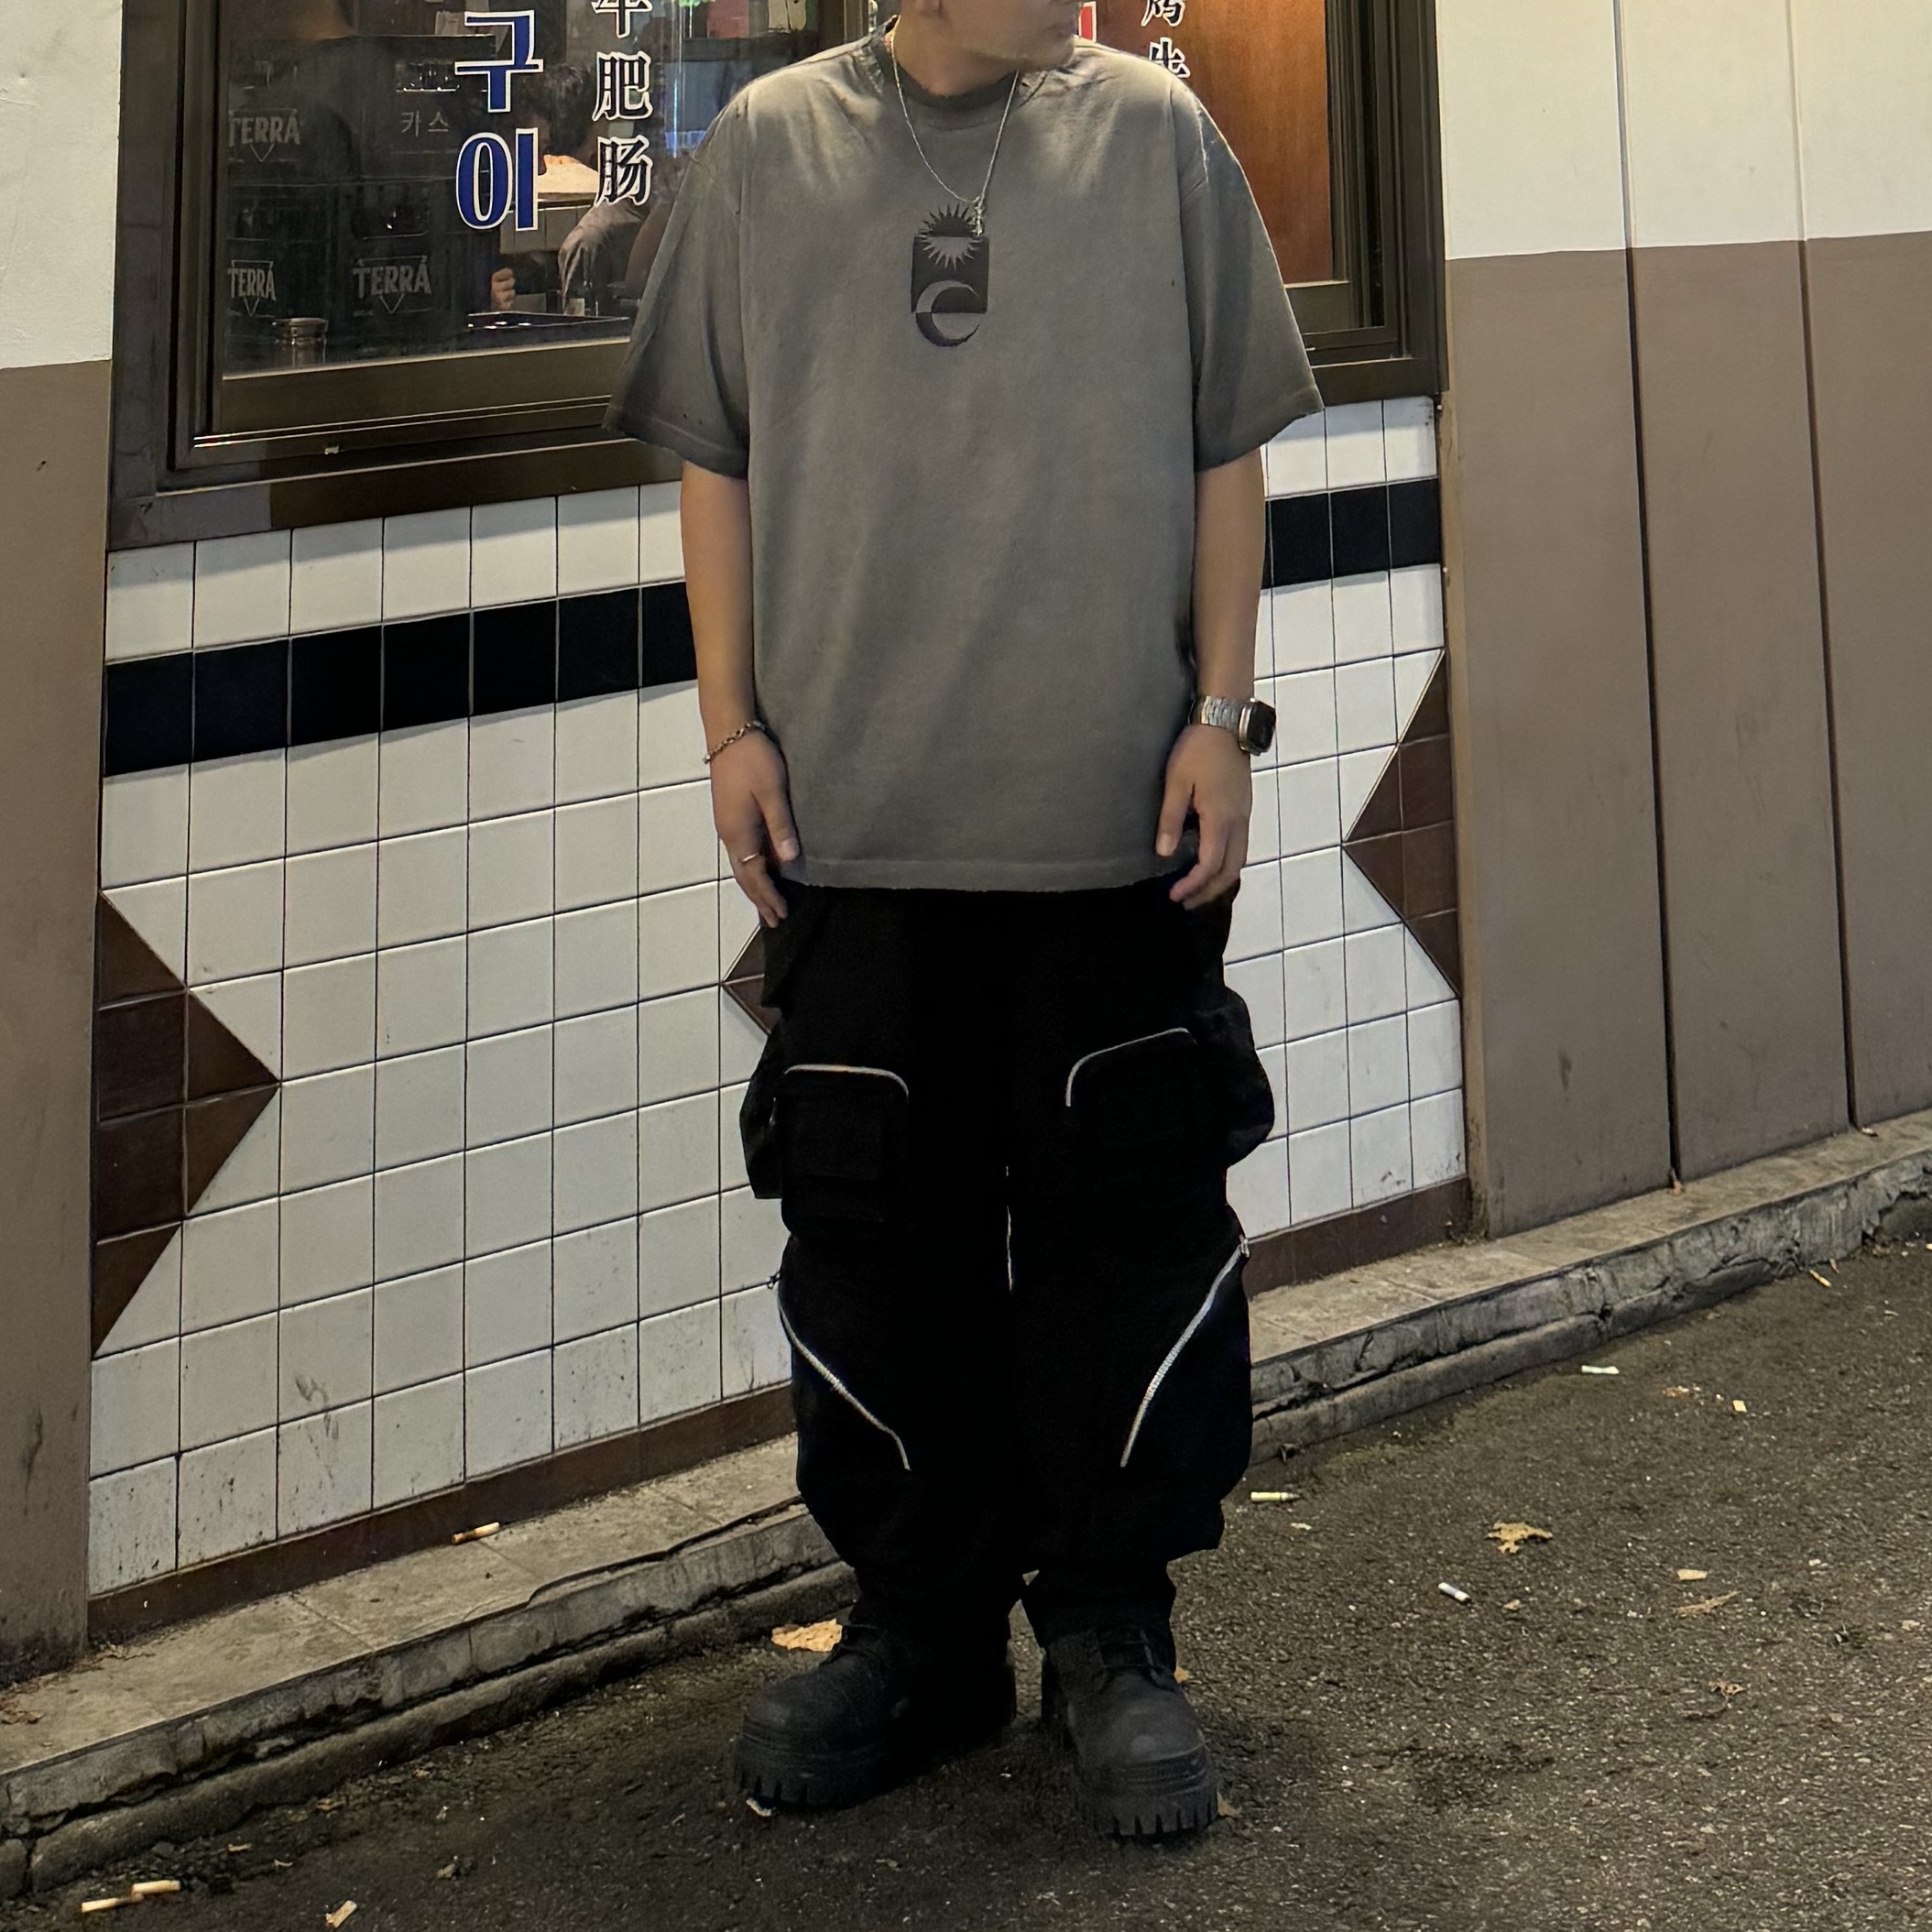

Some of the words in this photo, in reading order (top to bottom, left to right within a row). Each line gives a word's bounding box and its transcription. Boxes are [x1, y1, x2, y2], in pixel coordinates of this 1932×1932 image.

[228, 115, 300, 147] TERRA
[401, 109, 449, 136] 카스
[454, 10, 544, 231] 구이
[228, 267, 277, 300] TERRA
[353, 262, 432, 299] TERRA
